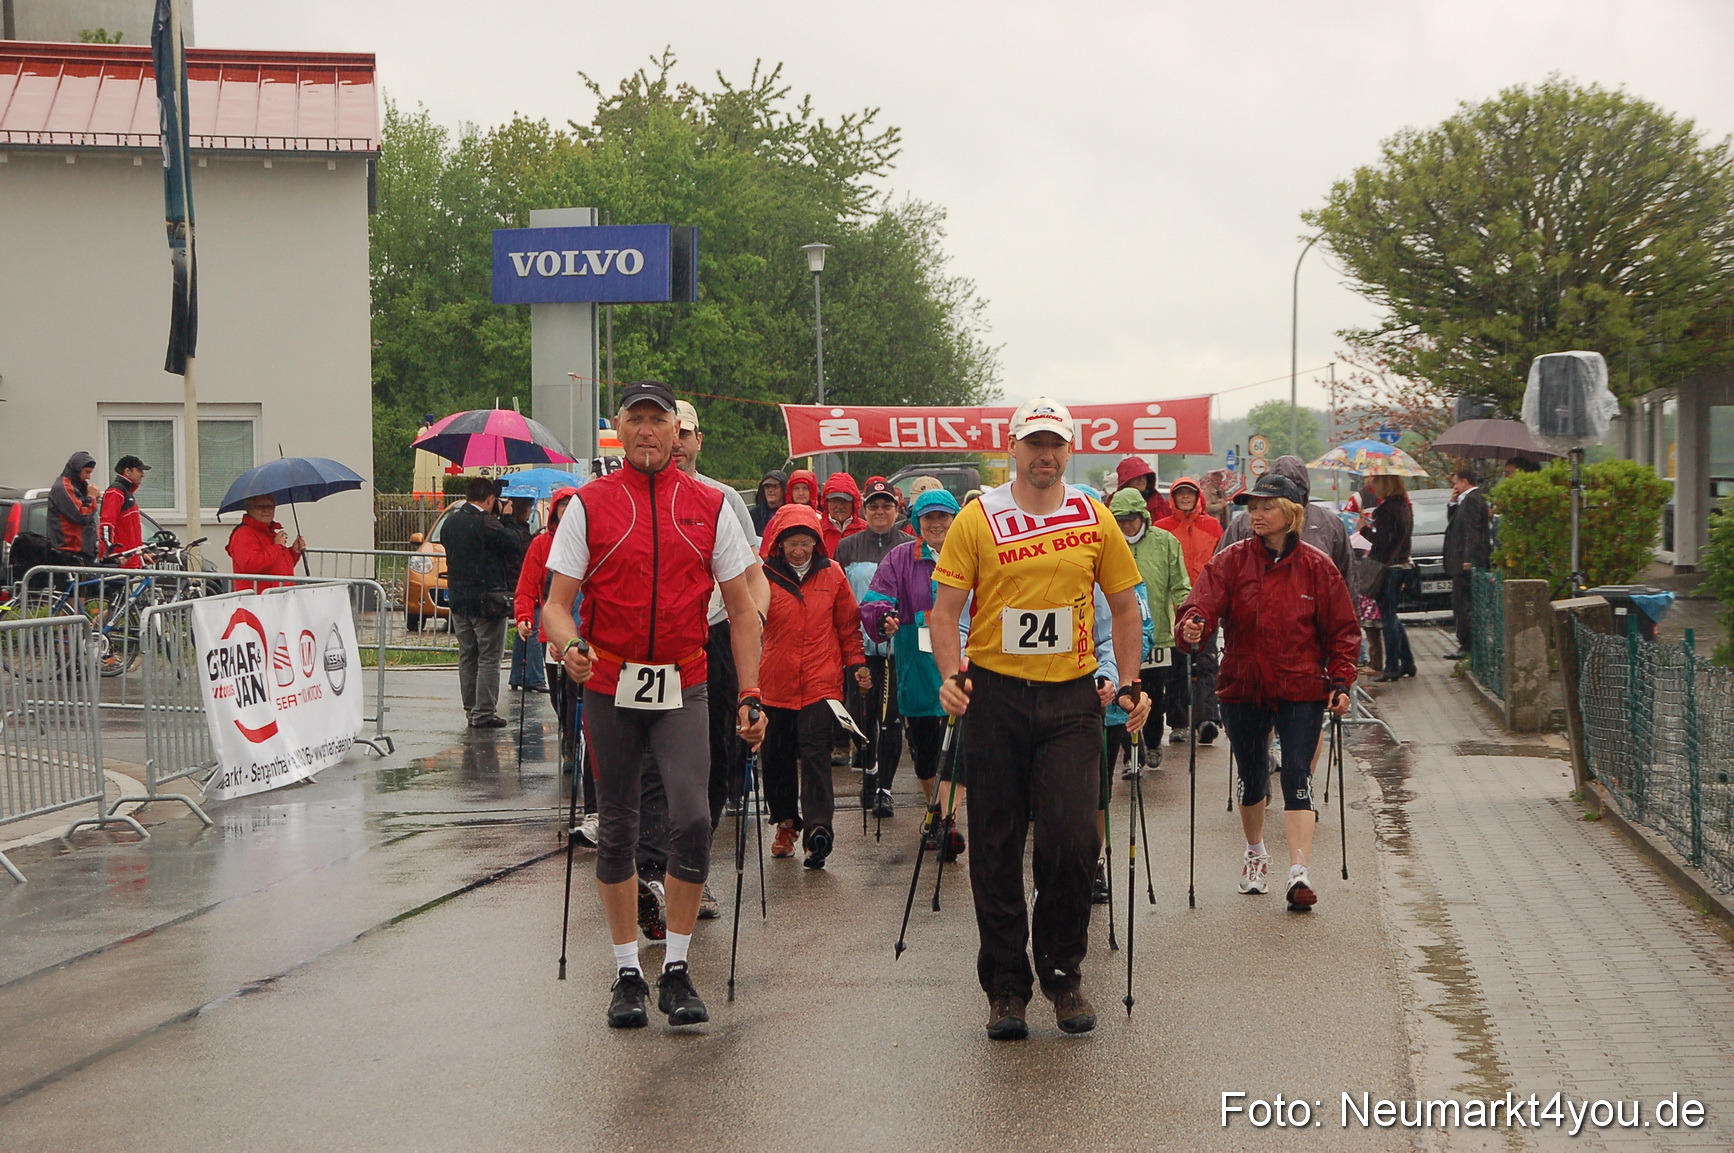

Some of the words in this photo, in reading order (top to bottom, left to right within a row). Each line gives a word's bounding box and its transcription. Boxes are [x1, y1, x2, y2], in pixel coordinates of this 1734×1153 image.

[508, 248, 645, 277] VOLVO
[1253, 441, 1265, 451] 60
[491, 466, 521, 476] 9222
[998, 542, 1048, 566] MAX
[1052, 531, 1102, 552] BÖGL
[1018, 612, 1059, 648] 24
[1147, 648, 1165, 665] 40
[634, 667, 667, 704] 21
